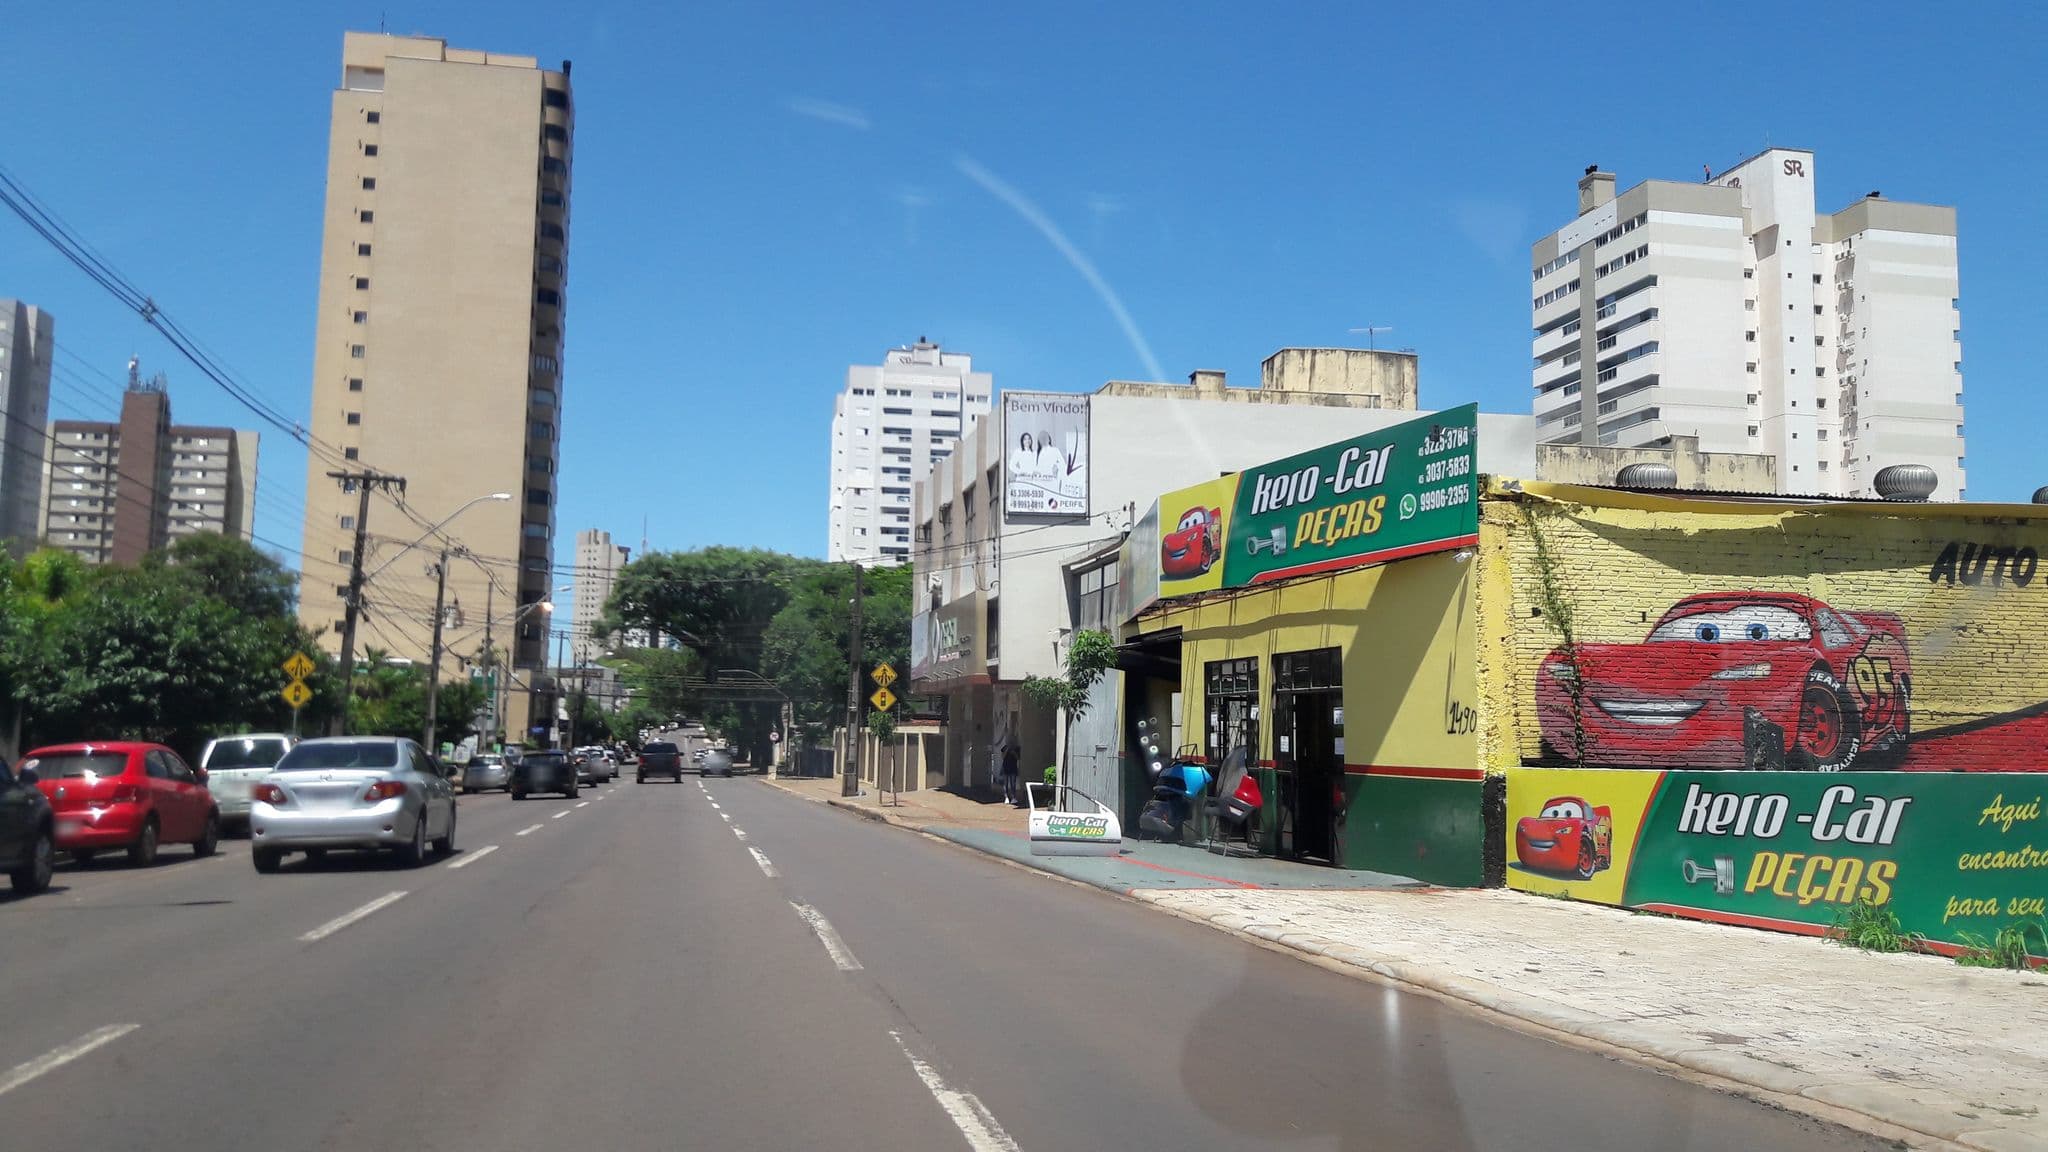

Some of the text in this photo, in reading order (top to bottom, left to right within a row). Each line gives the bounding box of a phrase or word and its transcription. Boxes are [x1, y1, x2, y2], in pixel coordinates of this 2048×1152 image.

[1011, 401, 1040, 413] Bem
[1426, 454, 1470, 483] 3037-5833
[1420, 483, 1469, 512] 99906-2355
[1293, 494, 1386, 549] PEÇAS
[1929, 541, 2039, 588] AUTO
[1447, 701, 1477, 735] 1490
[1978, 793, 2041, 833] Aqui
[1744, 851, 1898, 906] PEÇAS
[1942, 895, 2000, 925] para
